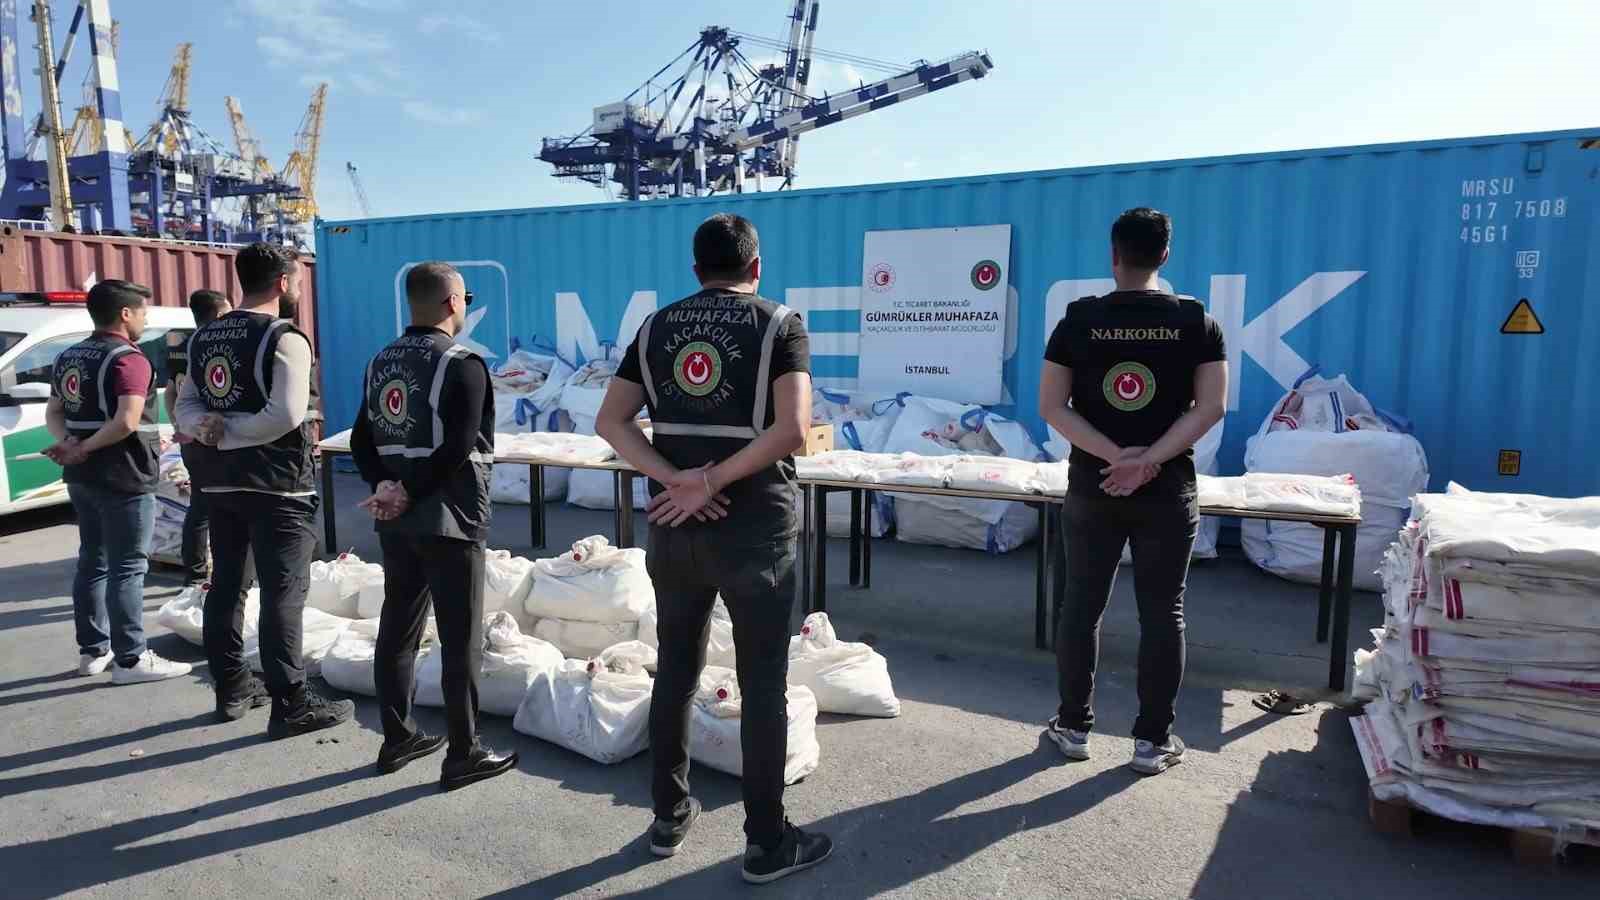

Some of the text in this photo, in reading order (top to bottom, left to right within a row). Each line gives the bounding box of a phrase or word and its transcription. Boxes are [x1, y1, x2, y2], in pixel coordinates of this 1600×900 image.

[1461, 178, 1514, 197] MRSU
[1461, 198, 1567, 220] 817 7508
[1460, 225, 1508, 243] 45G1
[665, 310, 753, 325] MUHAFAZA
[865, 310, 999, 323] GÜMRÜKLER MUHAFAZA
[1091, 326, 1181, 340] NARKOKİM
[664, 323, 743, 362] KAÇAKÇILIK
[905, 363, 950, 375] İSTANBUL
